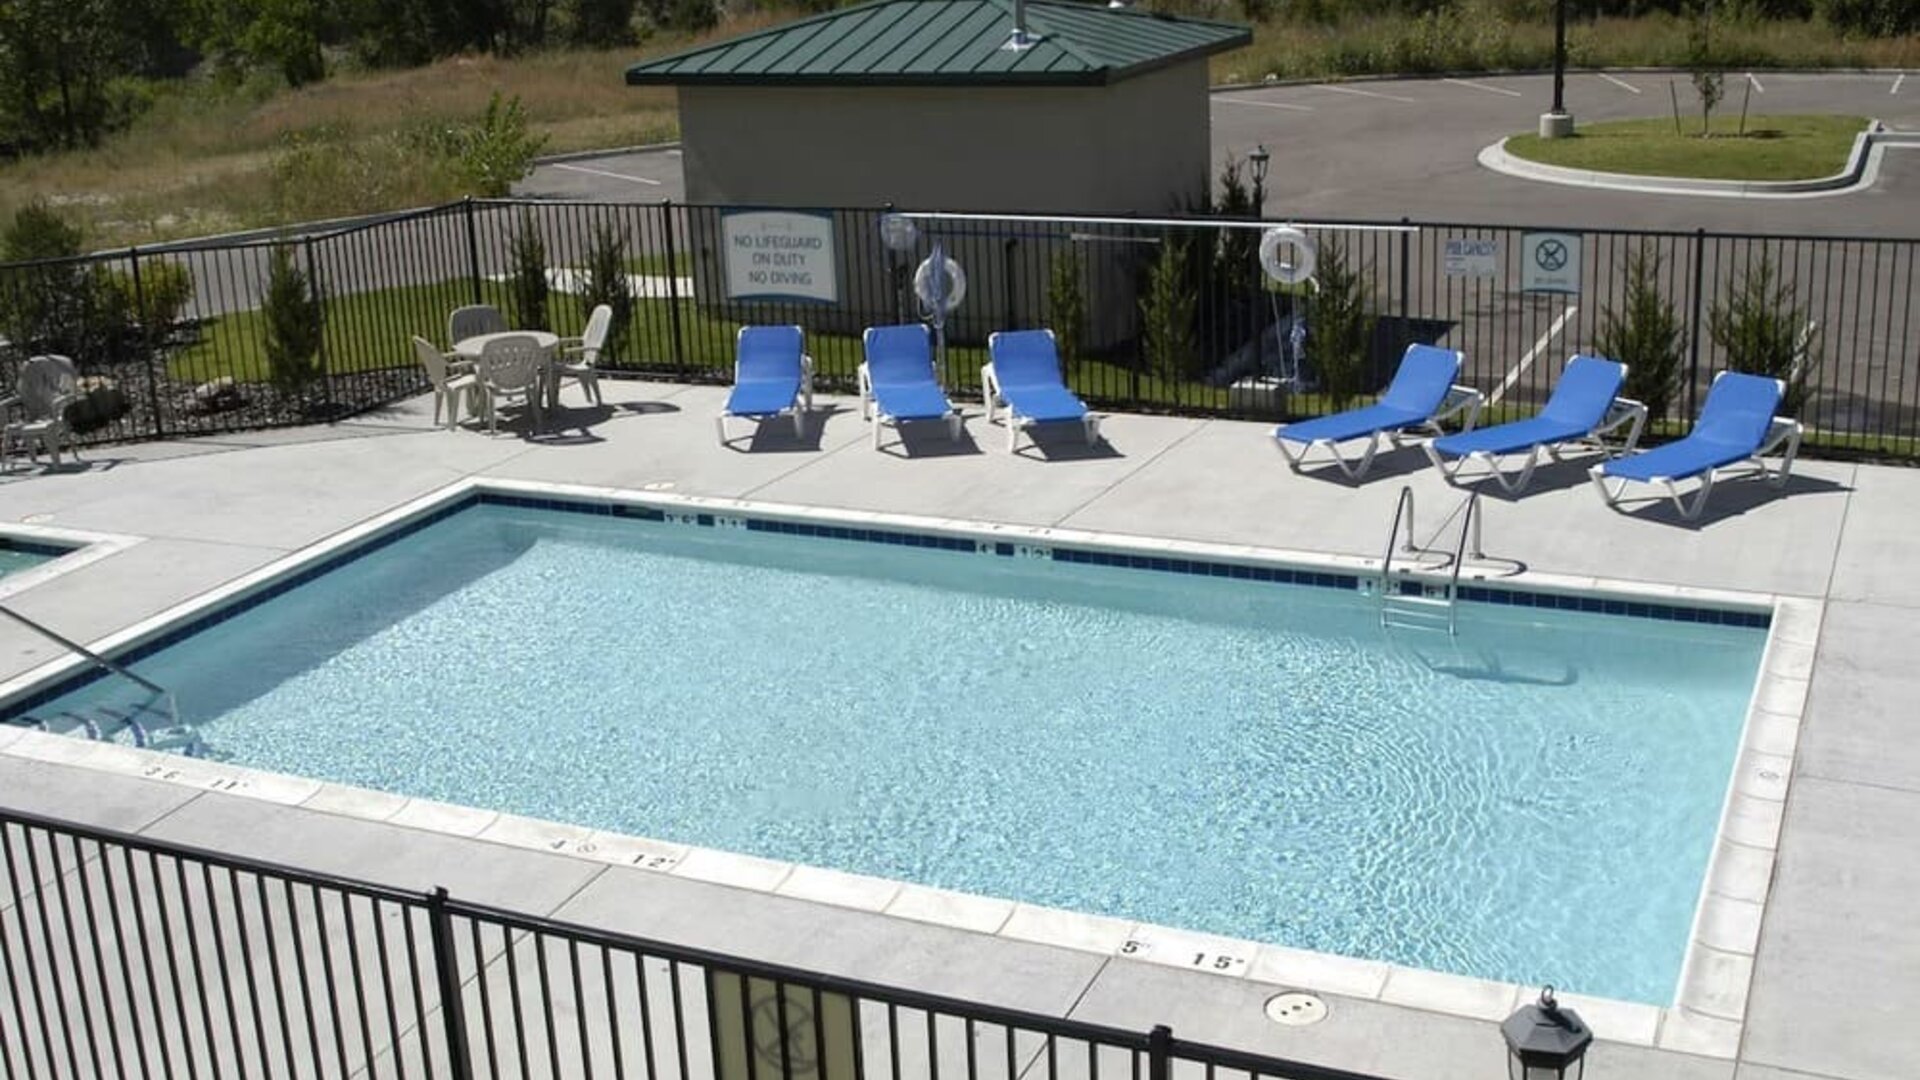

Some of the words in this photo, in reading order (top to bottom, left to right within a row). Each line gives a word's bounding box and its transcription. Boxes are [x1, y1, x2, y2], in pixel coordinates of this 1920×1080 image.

[734, 235, 752, 248] NO
[755, 236, 822, 250] LIFEGUARD
[752, 252, 770, 266] ON
[774, 253, 806, 266] DUTY
[748, 270, 767, 284] NO
[770, 272, 812, 286] DIVING
